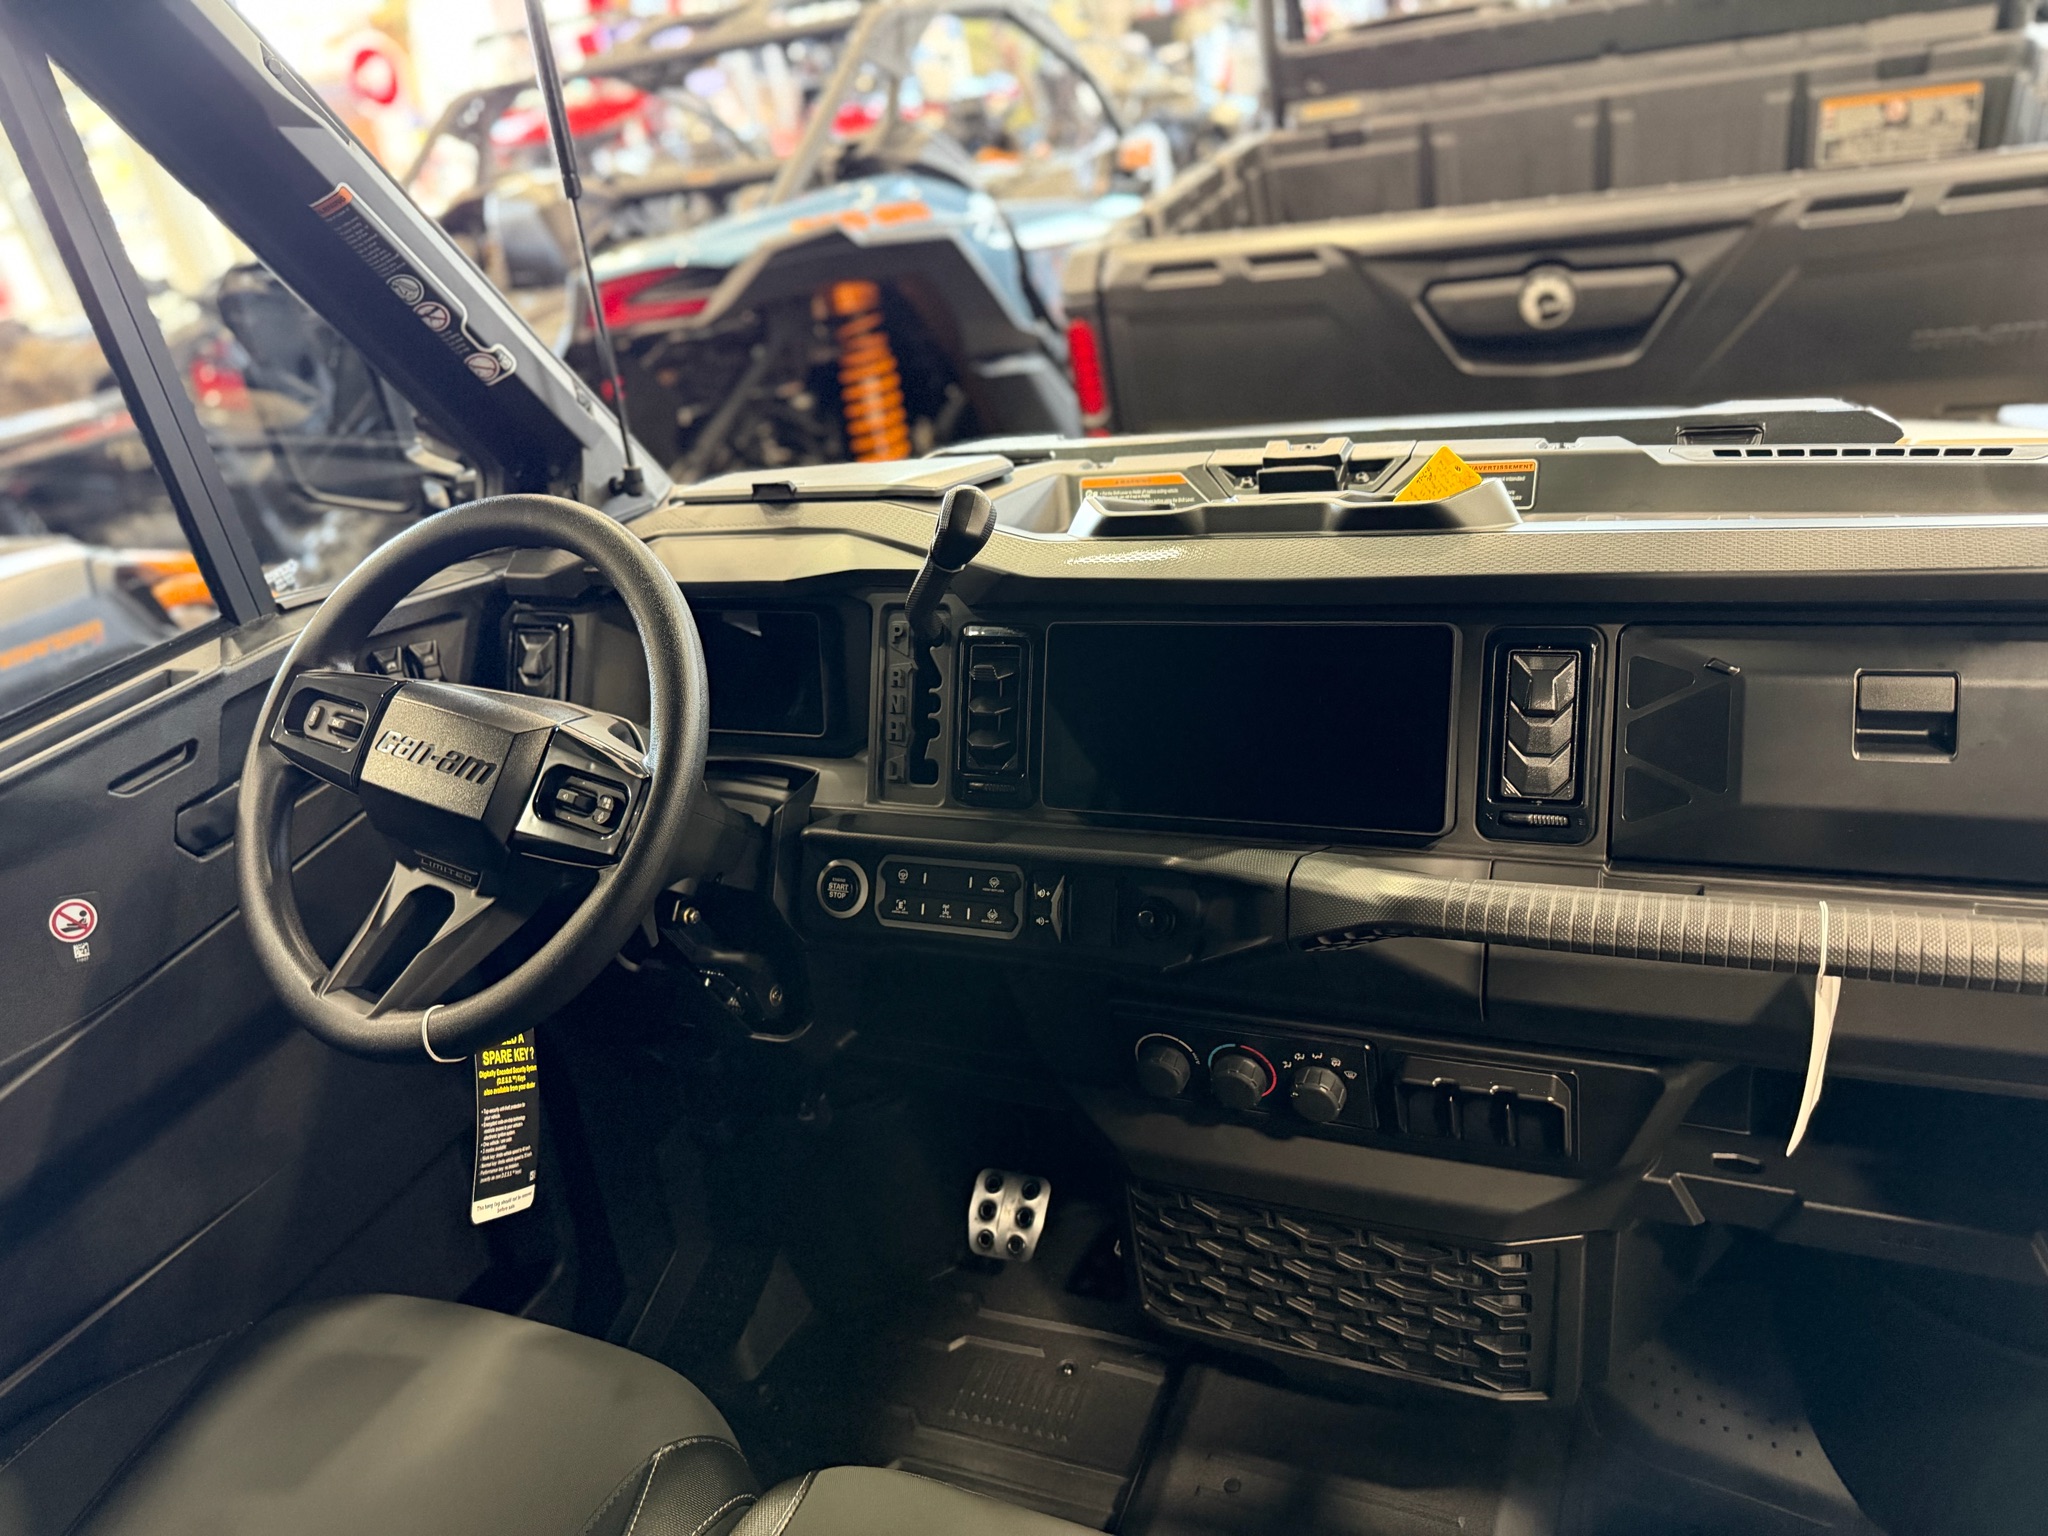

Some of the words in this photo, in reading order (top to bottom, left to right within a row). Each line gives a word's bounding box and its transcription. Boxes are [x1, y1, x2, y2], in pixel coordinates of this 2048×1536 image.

[892, 625, 904, 644] P
[891, 669, 905, 688] R
[890, 694, 905, 714] N
[888, 721, 905, 742] H
[421, 857, 472, 882] LIMITED
[828, 882, 849, 891] START
[829, 891, 846, 899] STOP
[518, 1033, 525, 1044] A
[482, 1048, 513, 1066] SPARE
